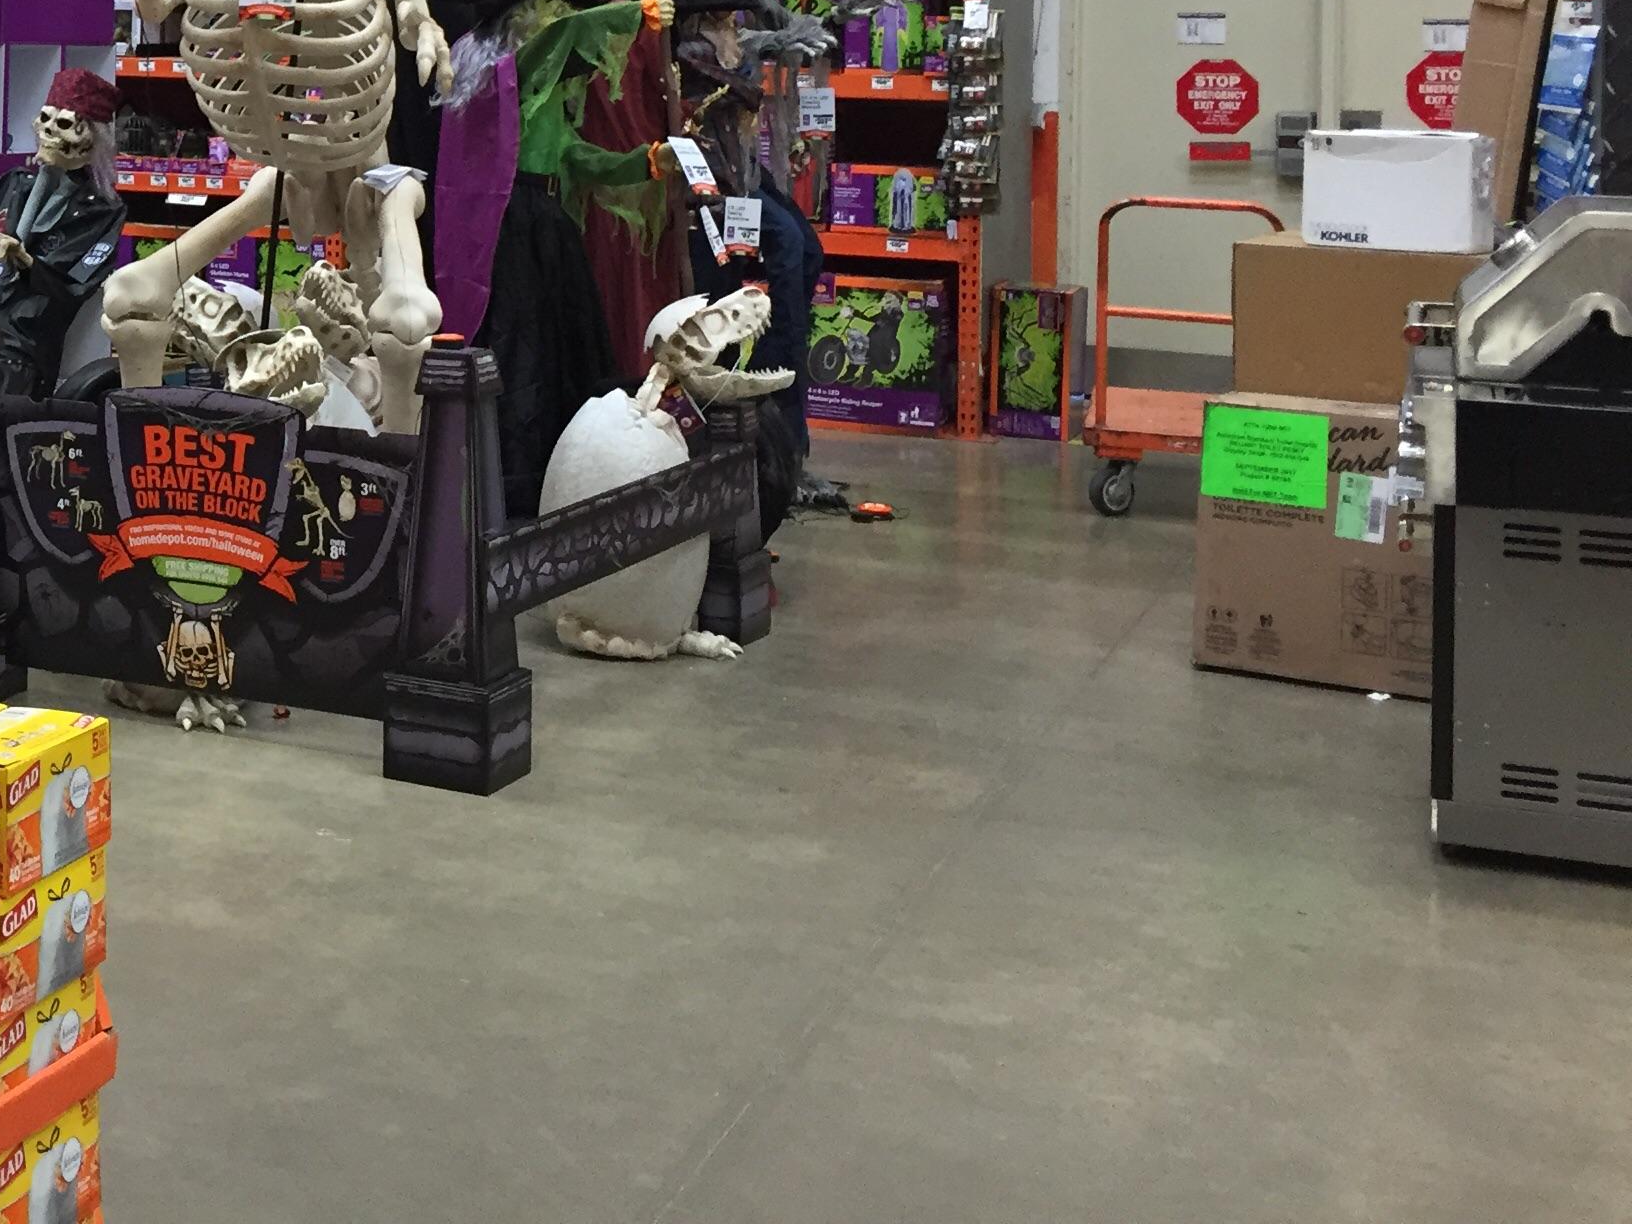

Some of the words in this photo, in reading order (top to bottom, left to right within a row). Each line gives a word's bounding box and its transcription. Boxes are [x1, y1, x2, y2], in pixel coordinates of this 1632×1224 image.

[1195, 75, 1241, 88] STOP
[1426, 69, 1462, 81] STO
[1188, 90, 1247, 100] EMERGENCY
[1194, 101, 1214, 110] EXIT
[1219, 101, 1241, 110] ONLY
[1320, 231, 1369, 243] KOHLER
[144, 424, 255, 474] BEST
[131, 464, 267, 502] GRAVEYARD
[136, 490, 160, 509] ON
[165, 491, 199, 511] THE
[203, 495, 262, 523] BLOCK
[129, 532, 264, 563] homedepot.com/halloween
[91, 732, 100, 751] 5
[9, 765, 39, 806] GLAD
[90, 855, 98, 876] 5
[1, 896, 36, 937] GLAD
